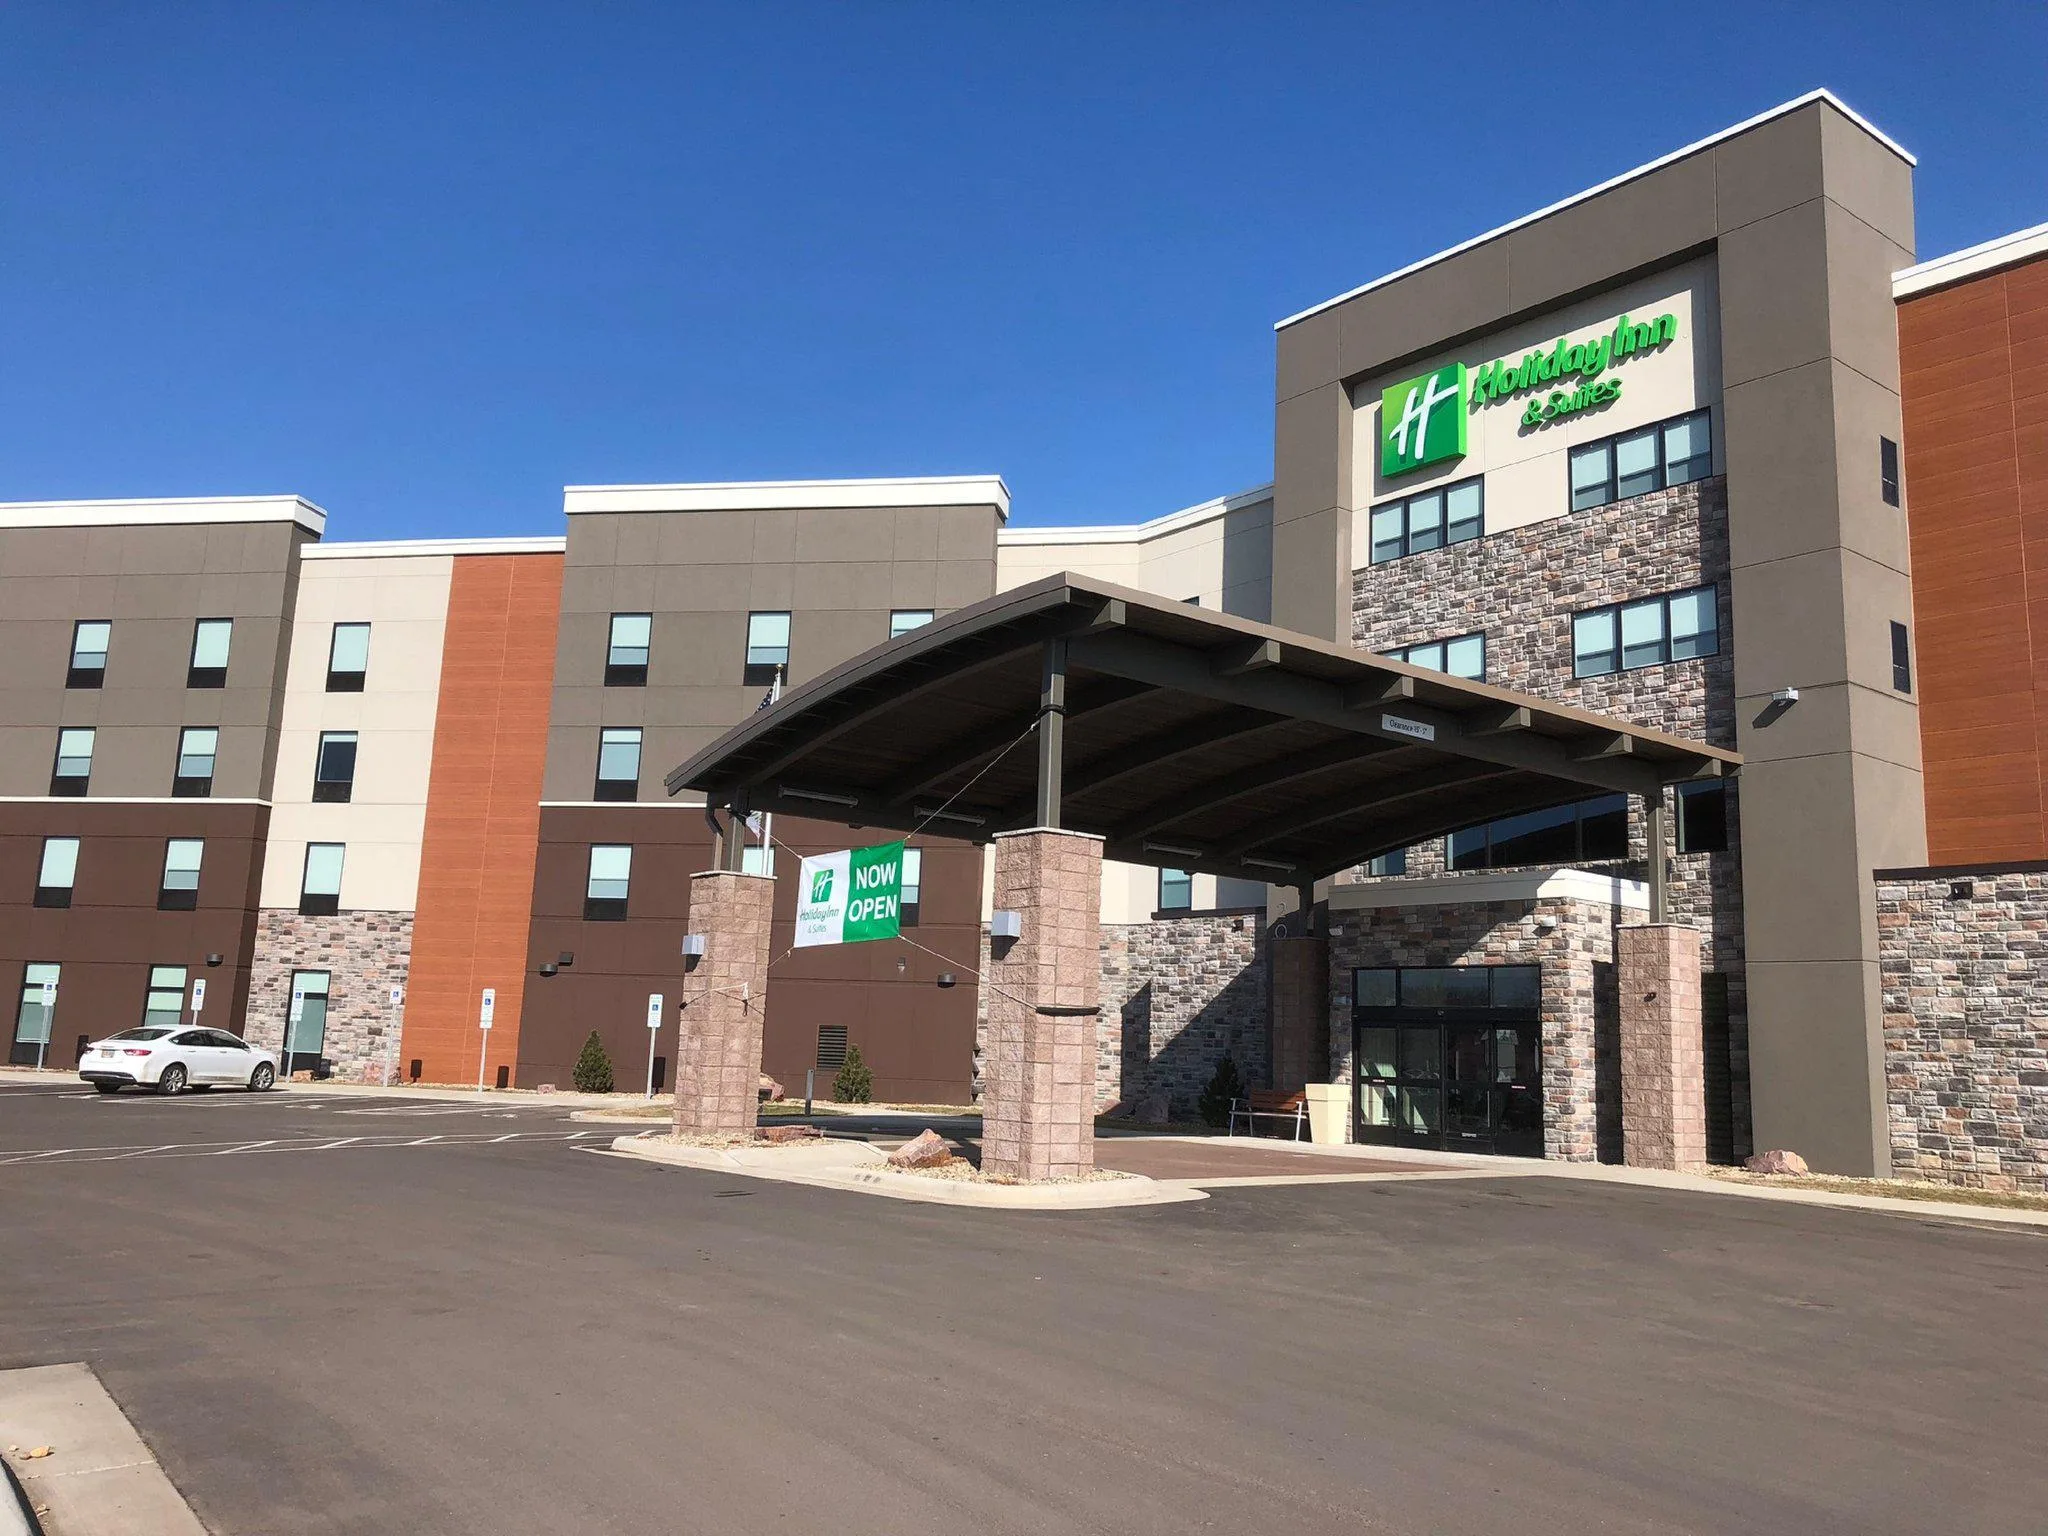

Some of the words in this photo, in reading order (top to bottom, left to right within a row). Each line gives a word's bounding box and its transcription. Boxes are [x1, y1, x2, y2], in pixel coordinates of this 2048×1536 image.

[1474, 336, 1611, 404] Holiday
[1613, 314, 1677, 357] Inn
[1522, 398, 1544, 425] &
[1544, 377, 1623, 419] Suites
[855, 861, 897, 890] NOW
[848, 894, 898, 922] OPEN
